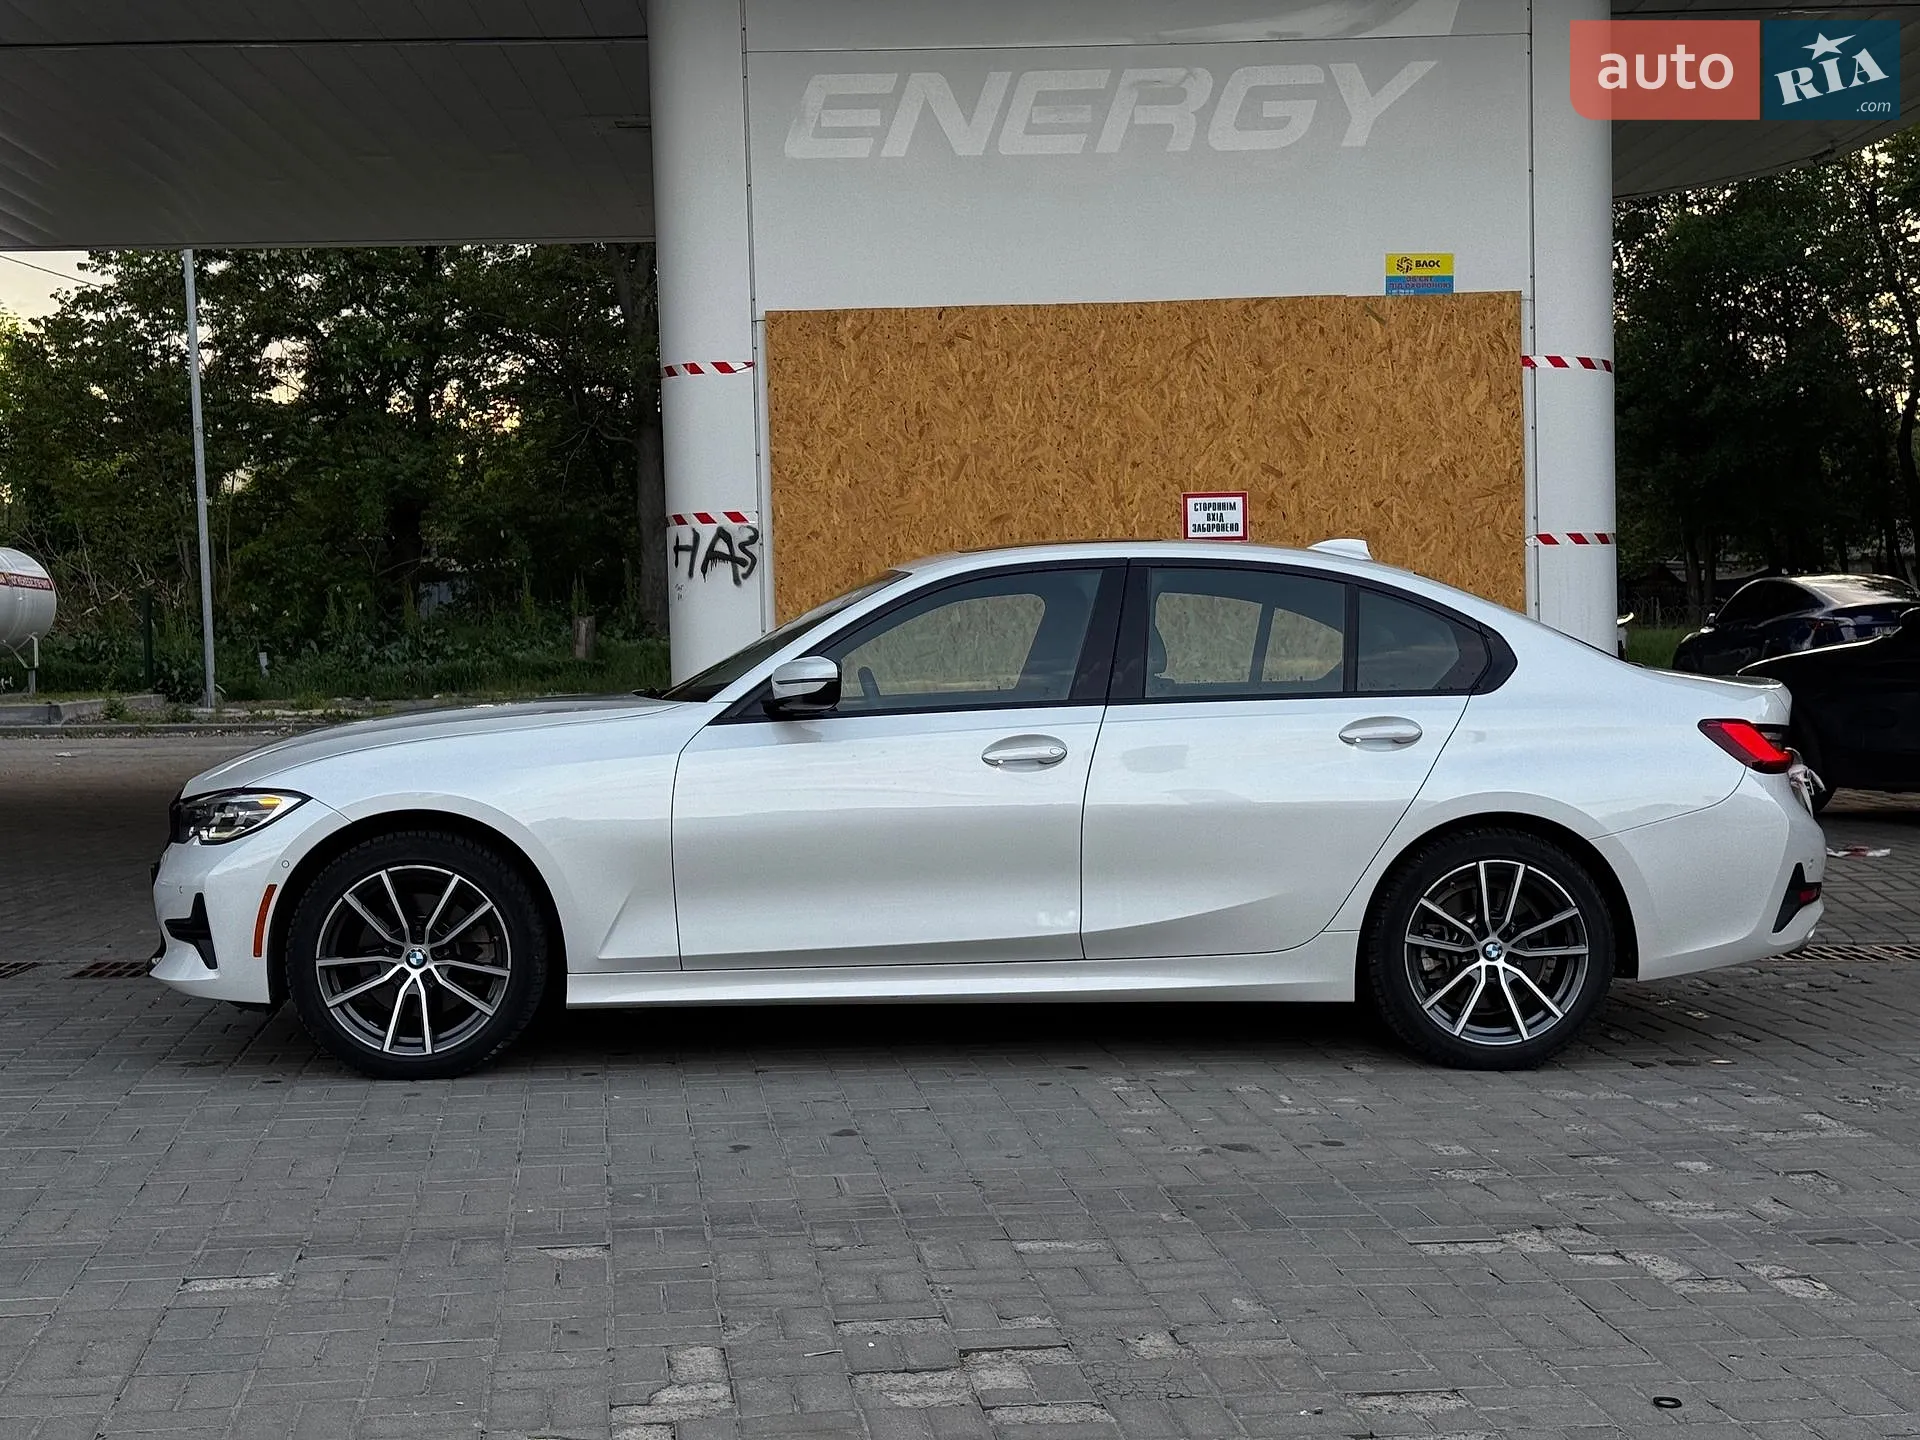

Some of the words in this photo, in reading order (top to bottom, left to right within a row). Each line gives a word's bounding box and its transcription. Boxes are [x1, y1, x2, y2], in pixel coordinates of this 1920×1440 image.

[784, 60, 1438, 158] ENERGY
[1194, 502, 1236, 511] СТОРОННІМ
[1207, 513, 1224, 522] ВХІД
[1192, 523, 1239, 532] ЗАБОРОНЕНО
